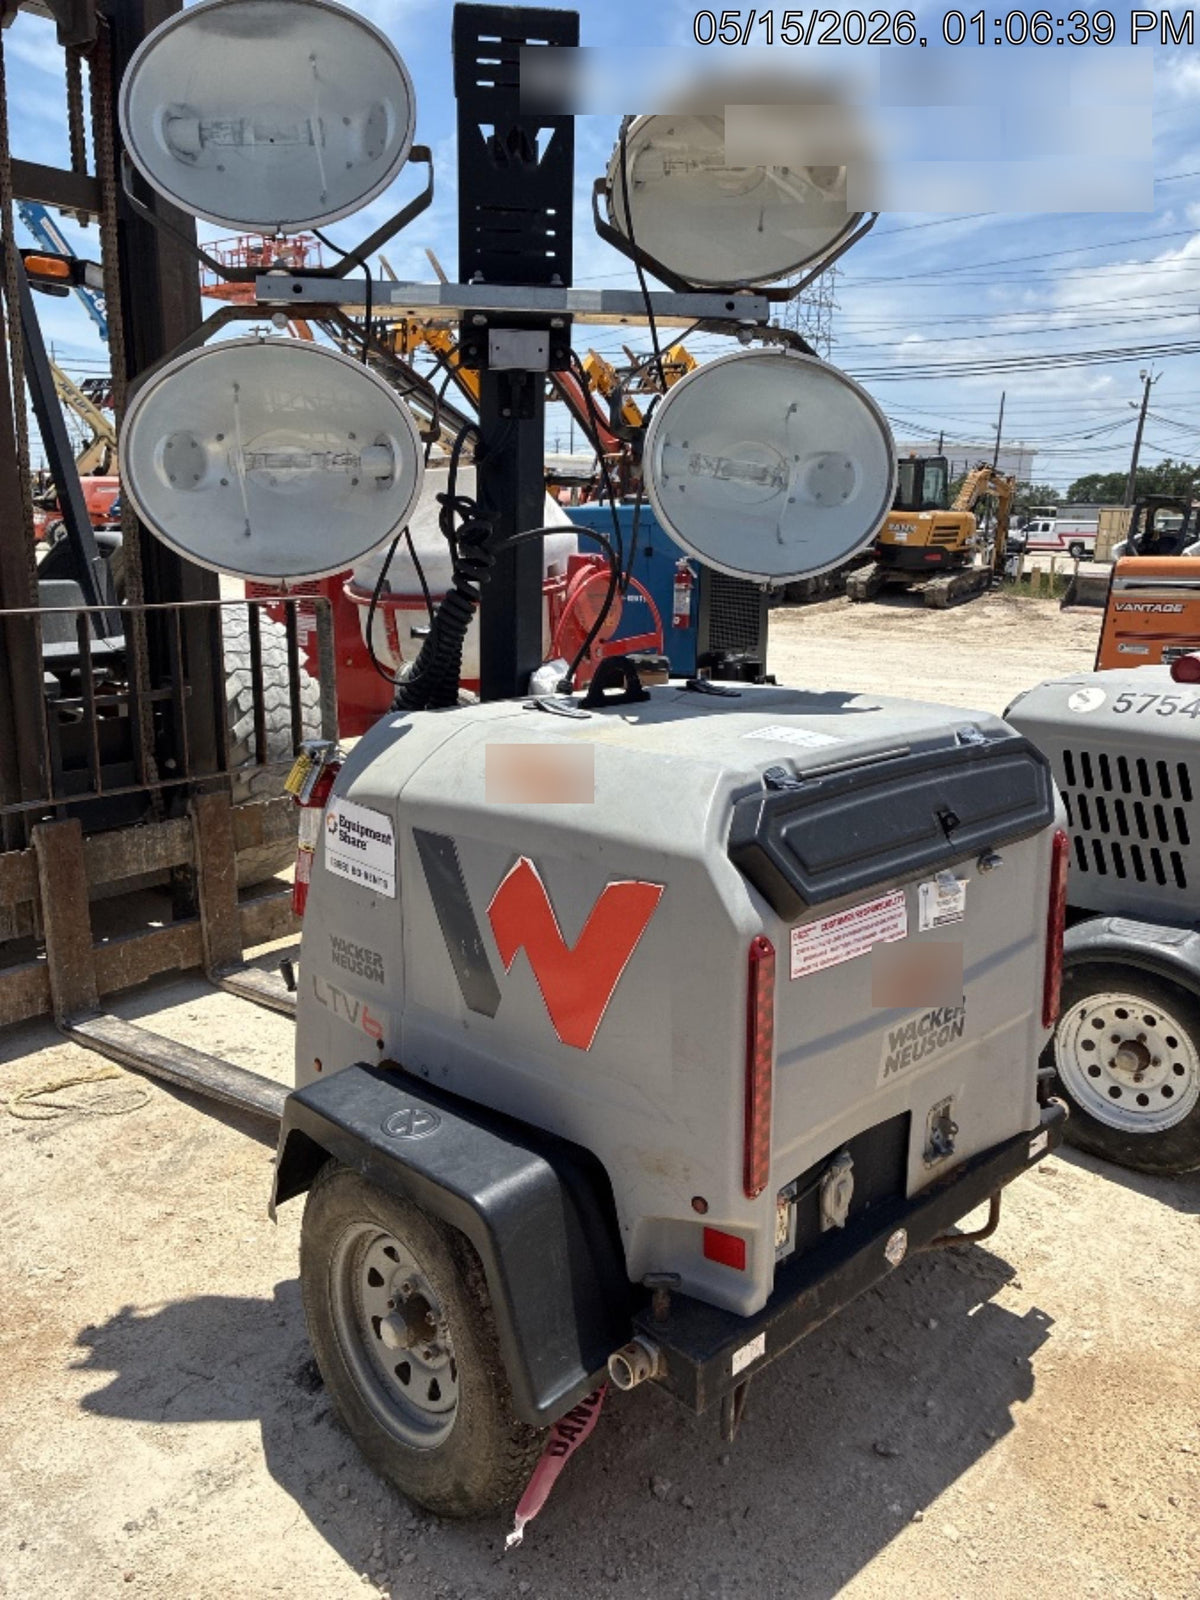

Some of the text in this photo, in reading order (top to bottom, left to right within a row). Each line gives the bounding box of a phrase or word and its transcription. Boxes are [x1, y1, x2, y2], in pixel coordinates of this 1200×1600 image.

[1114, 602, 1184, 613] VANTAGE
[1111, 692, 1200, 719] 5754
[339, 814, 392, 847] Equipment
[339, 829, 368, 851] Share
[329, 932, 385, 971] WACKER
[332, 949, 385, 986] NEUSON
[312, 974, 385, 1040] LTV6
[883, 1016, 965, 1079] NEUSON
[546, 1384, 606, 1457] DANG
